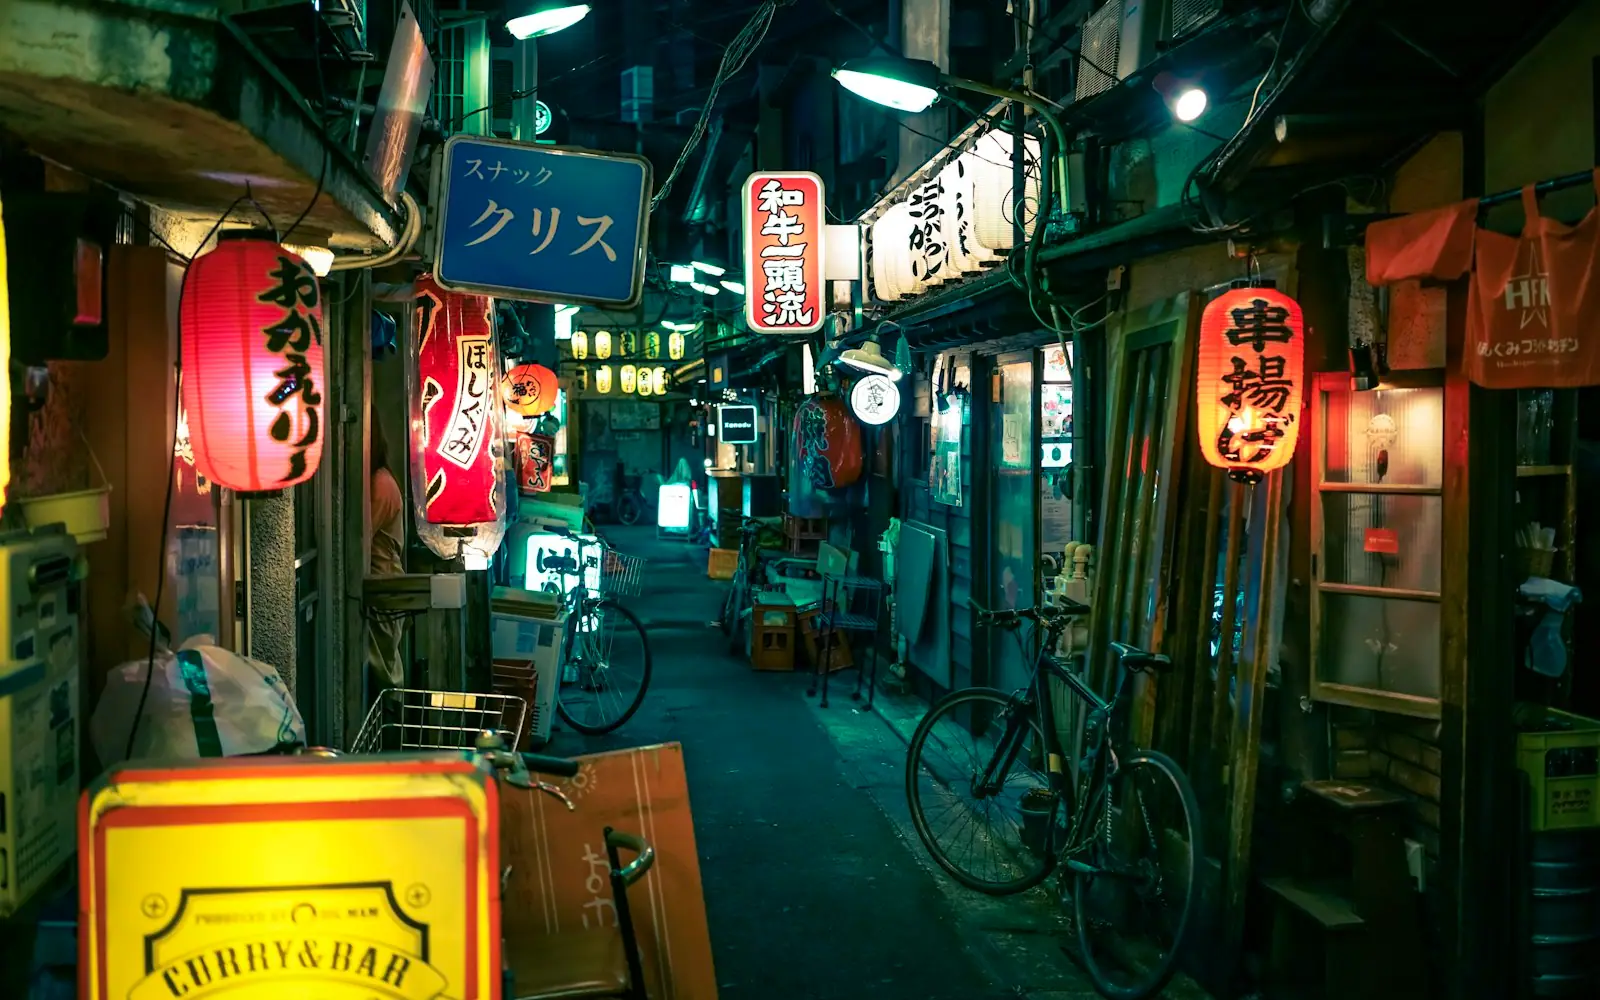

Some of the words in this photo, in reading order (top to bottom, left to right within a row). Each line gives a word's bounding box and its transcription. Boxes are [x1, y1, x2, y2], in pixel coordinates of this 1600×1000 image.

[463, 158, 553, 187] スナック
[463, 198, 617, 263] クリス
[757, 178, 814, 327] 和牛一頭流
[447, 344, 488, 455] ほしぐみ
[1217, 298, 1295, 464] 串揚げ
[161, 939, 411, 998] CURRY&BAR
